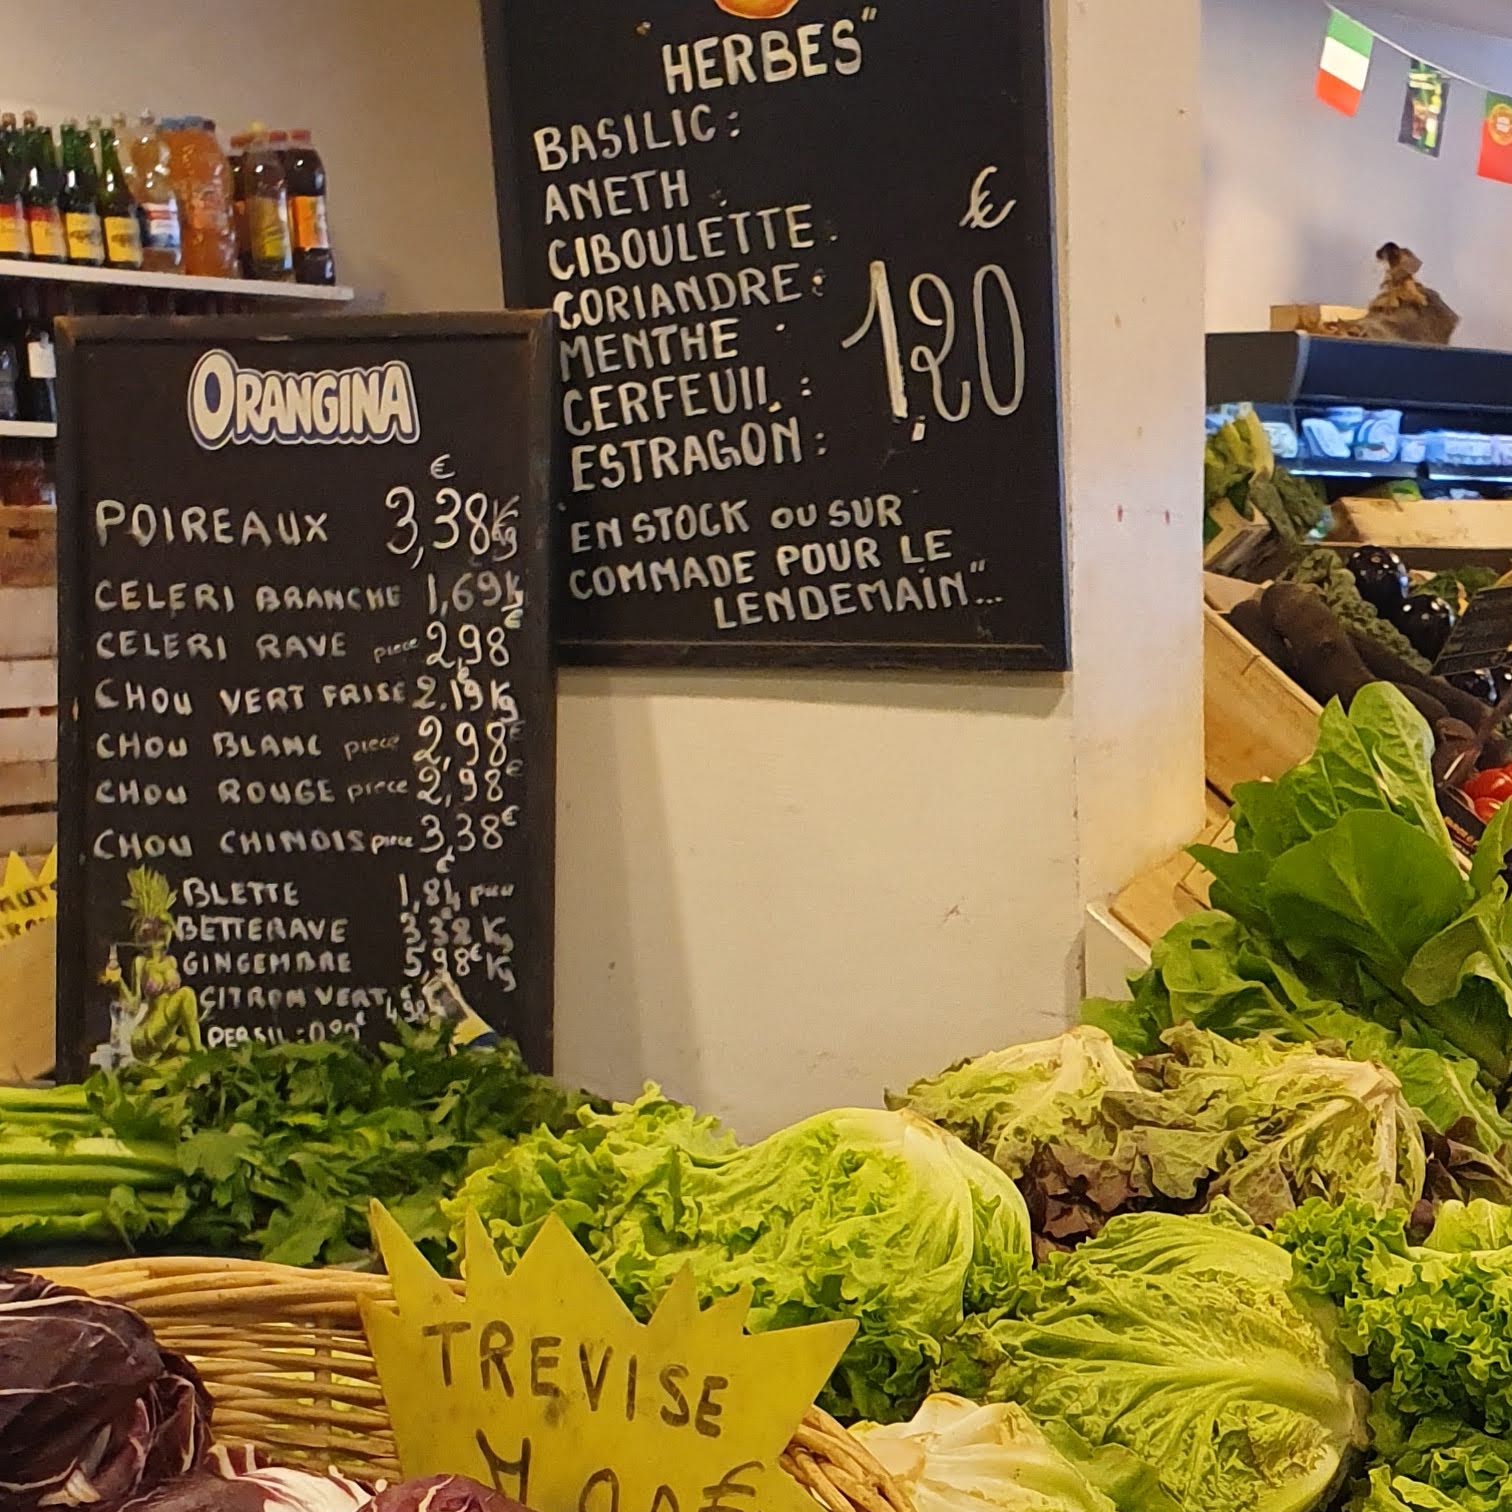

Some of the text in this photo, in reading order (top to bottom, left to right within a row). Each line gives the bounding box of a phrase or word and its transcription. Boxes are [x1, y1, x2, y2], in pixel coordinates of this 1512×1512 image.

[545, 169, 689, 225] ANETH
[549, 204, 815, 281] CIBOULETTE
[559, 318, 740, 382] MENTHE
[95, 500, 329, 548] POIREAUX
[570, 516, 623, 554] EN
[632, 499, 750, 544] STOCK
[828, 494, 902, 528] SUR
[569, 528, 953, 600] COMMADE POUR LE
[95, 580, 235, 613] CELERI
[256, 585, 401, 611] BRANCHE
[96, 631, 227, 660] CELERI
[256, 633, 347, 661] RAVE
[95, 679, 193, 717] CHOU
[220, 684, 305, 717] VERT
[323, 682, 406, 708] FRISE
[96, 733, 189, 760] CHOU
[213, 732, 322, 759] BLANC
[96, 781, 188, 805] CHOU
[217, 779, 336, 804] ROUGE
[93, 829, 194, 861] CHOU
[220, 829, 365, 854] CHINOIS
[184, 877, 299, 908] BLETTE
[176, 915, 349, 943] BETTERAVE
[183, 950, 352, 976] GINGEMBRE
[314, 985, 388, 1008] VERT
[422, 1319, 729, 1439] TREVISE
